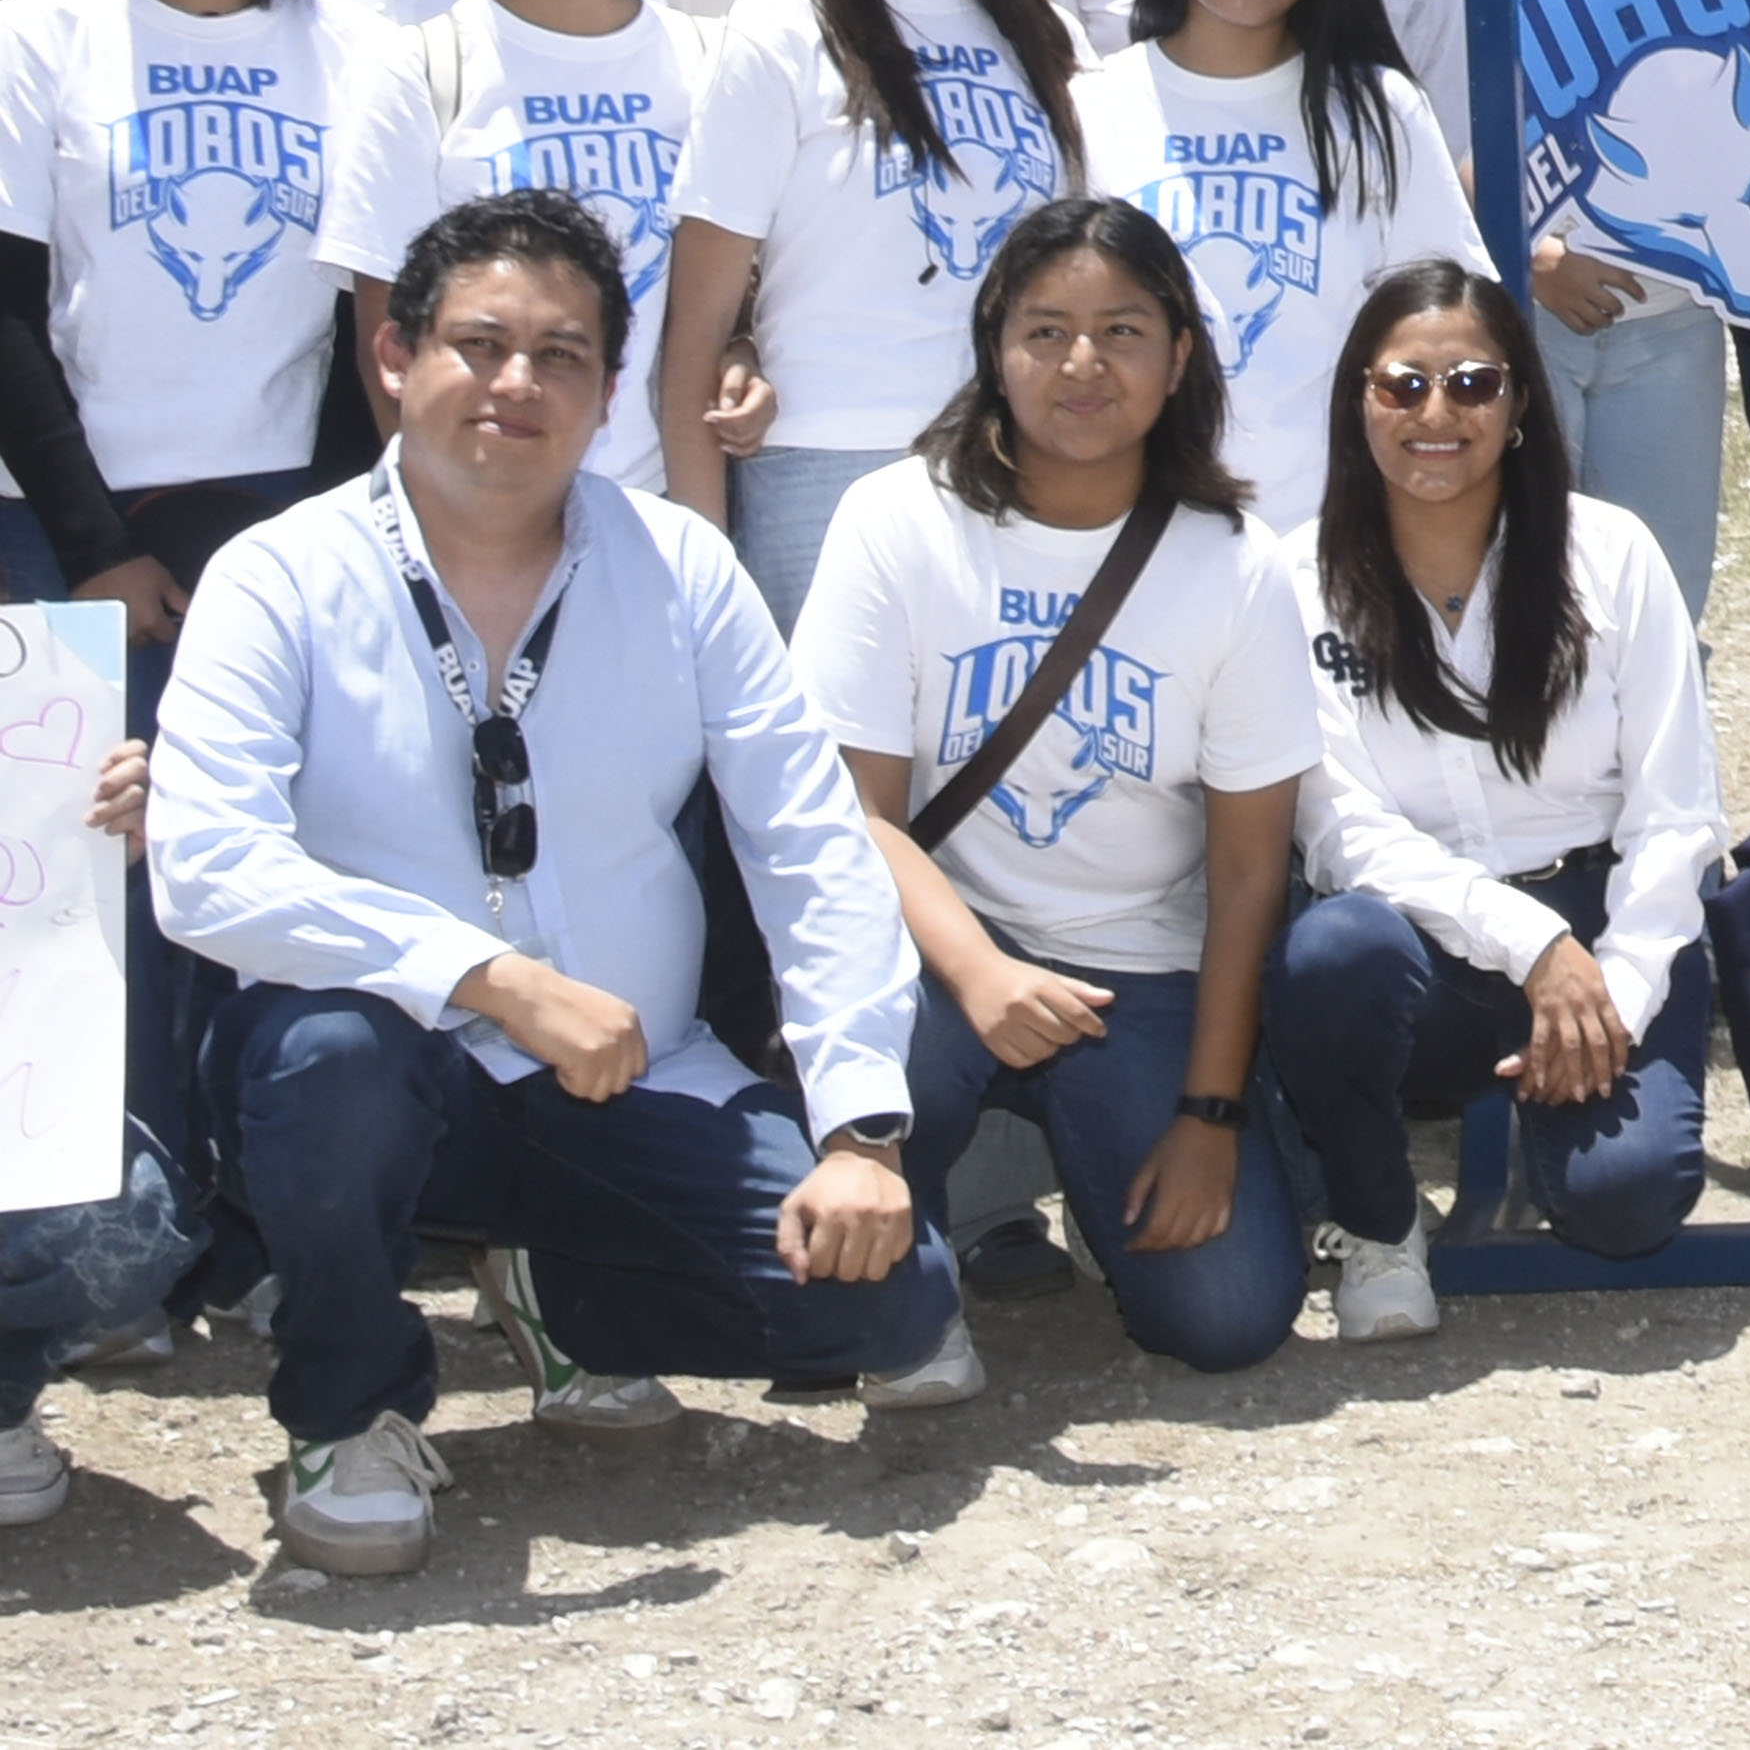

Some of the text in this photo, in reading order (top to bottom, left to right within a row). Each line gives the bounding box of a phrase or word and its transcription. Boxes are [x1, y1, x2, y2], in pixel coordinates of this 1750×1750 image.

[148, 63, 279, 96] BUAP
[917, 45, 999, 76] UAP
[523, 93, 652, 125] BUAP
[113, 105, 321, 196] LOBOS
[1164, 133, 1287, 165] BUAP
[881, 154, 912, 196] DE
[116, 184, 158, 224] DEL
[275, 182, 317, 225] SUR
[1128, 175, 1318, 260] OBOS
[1272, 248, 1315, 287] SUR
[1000, 587, 1082, 628] BUA
[434, 643, 478, 725] BUA
[497, 657, 539, 719] UAP
[948, 641, 1150, 747] LOOS
[1103, 733, 1149, 777] SUR
